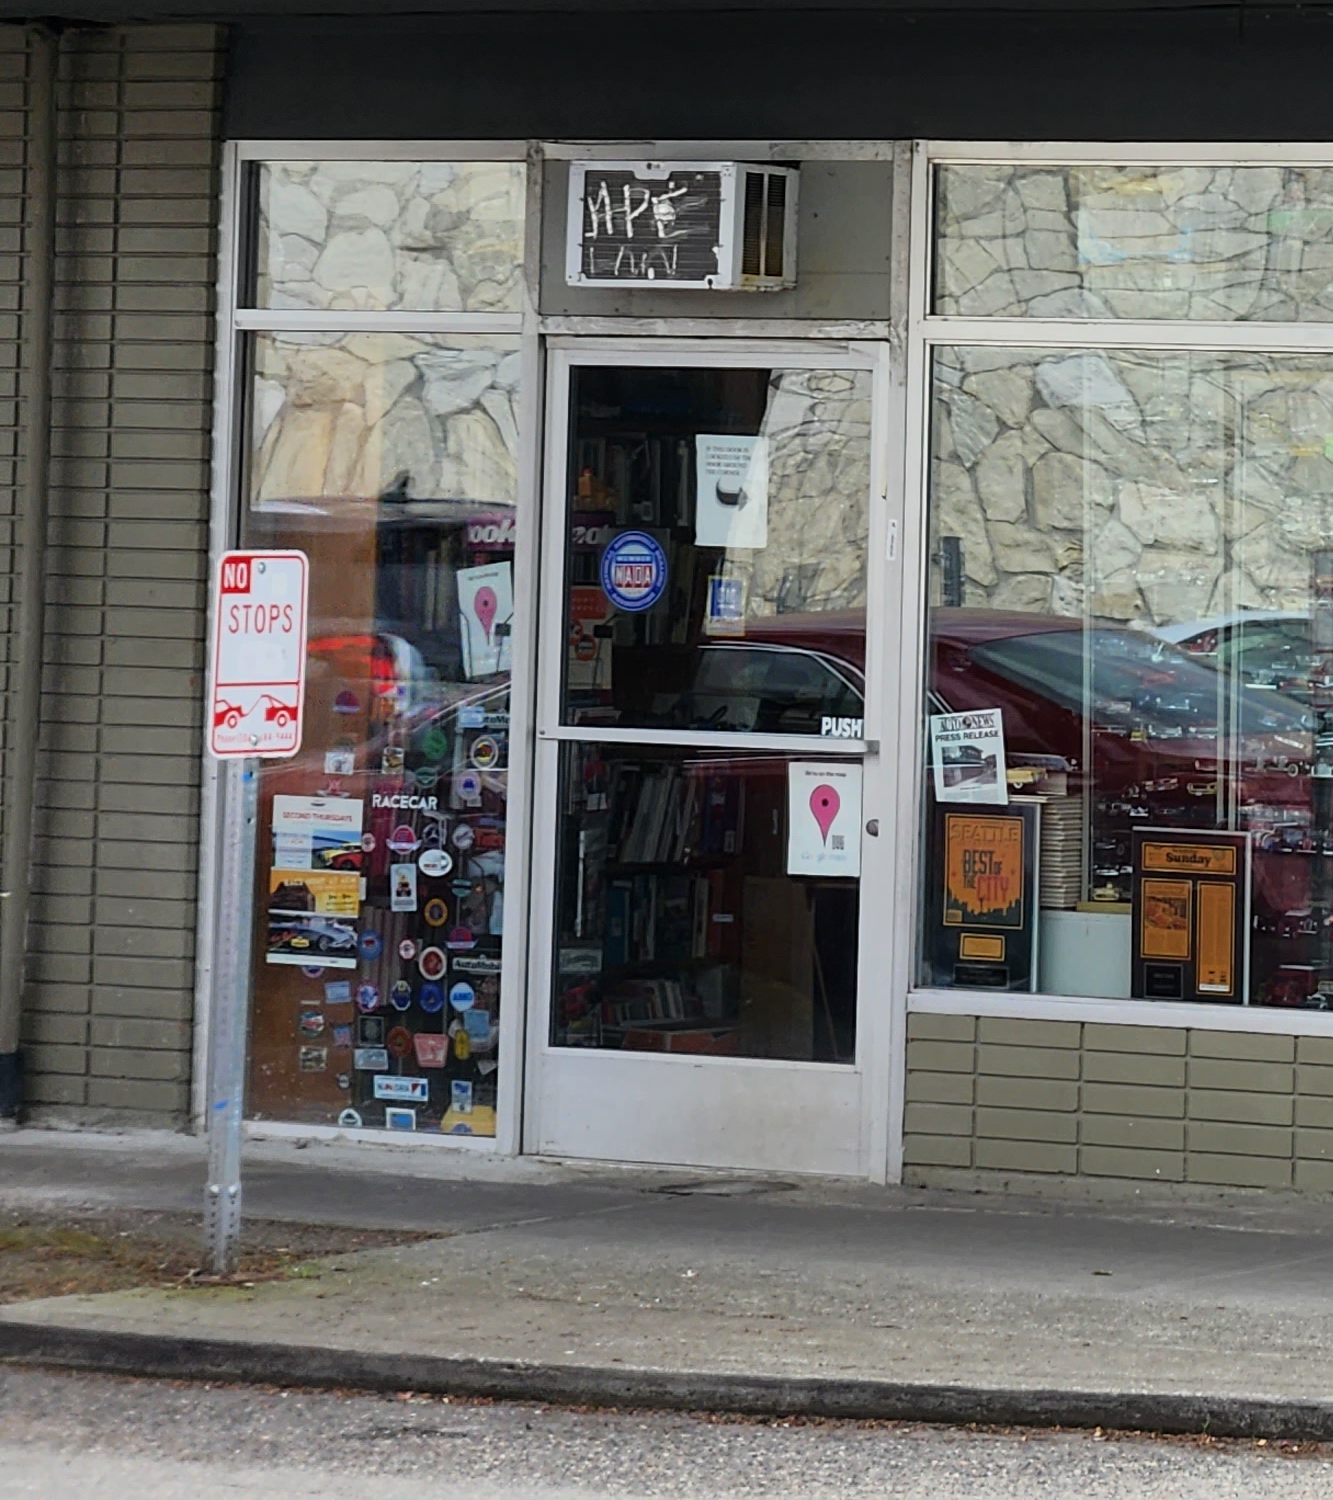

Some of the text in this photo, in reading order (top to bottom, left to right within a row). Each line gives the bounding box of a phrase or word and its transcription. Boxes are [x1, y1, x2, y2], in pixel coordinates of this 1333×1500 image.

[223, 562, 248, 589] NO
[228, 603, 293, 634] STOPS
[821, 716, 863, 738] PUSH
[935, 730, 999, 742] PRESS RELEASE
[372, 794, 438, 810] RACECAR
[963, 849, 994, 875] BEST
[1165, 852, 1212, 867] Sunday
[976, 875, 1009, 902] CITY
